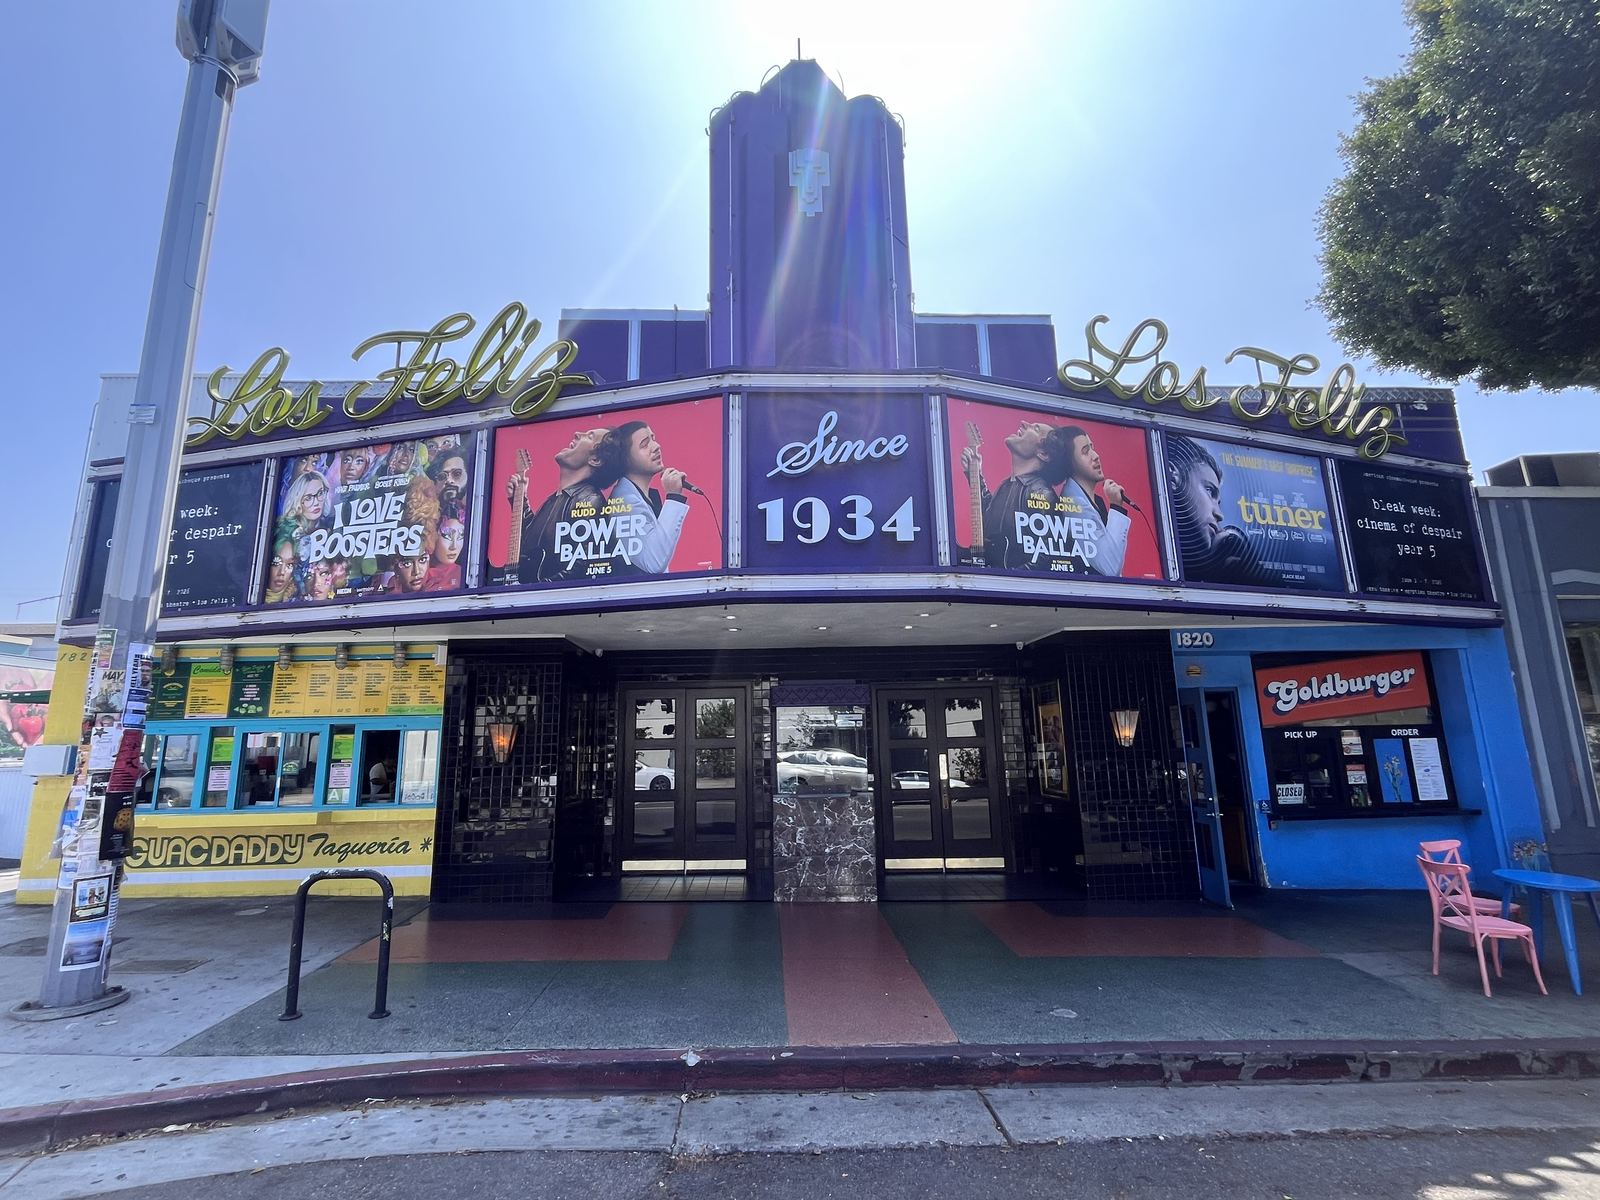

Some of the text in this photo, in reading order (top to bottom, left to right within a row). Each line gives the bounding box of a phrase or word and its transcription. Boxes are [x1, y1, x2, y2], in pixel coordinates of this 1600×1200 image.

[185, 300, 594, 447] Los Feliz
[1057, 314, 1409, 461] Los Feliz
[766, 410, 910, 479] Since
[607, 497, 625, 506] NICK
[1030, 492, 1047, 501] PAUL
[1059, 496, 1074, 504] NICK
[179, 504, 220, 520] week:
[333, 491, 407, 530] I LOVE
[575, 501, 593, 509] PAUL
[600, 504, 633, 516] JONAS
[1027, 499, 1050, 510] RUDD
[1054, 502, 1083, 514] JONAS
[1371, 498, 1441, 518] bleak week:
[571, 508, 597, 519] RUDD
[757, 494, 922, 545] 1934
[1237, 495, 1326, 530] tuner
[184, 523, 242, 543] despair
[554, 514, 648, 554] POWER
[1014, 511, 1099, 545] POWER
[1356, 517, 1463, 540] cinema of despair
[309, 520, 425, 564] BOOSTERS
[186, 550, 196, 565] 5
[560, 537, 643, 571] BALLAD
[1023, 535, 1098, 567] BALLAD
[1396, 543, 1436, 558] year 5
[585, 565, 612, 576] JUNE 5
[1050, 563, 1075, 572] JUNE 5
[1176, 631, 1215, 648] 1820
[60, 652, 94, 662] 182
[102, 671, 124, 680] MAY
[1267, 667, 1416, 712] Goldburger
[1284, 730, 1318, 739] PICK UP
[1390, 728, 1420, 737] ORDER
[327, 788, 340, 801] A
[1277, 786, 1303, 797] CLOSED
[124, 832, 413, 869] GUACDADDY Taquería
